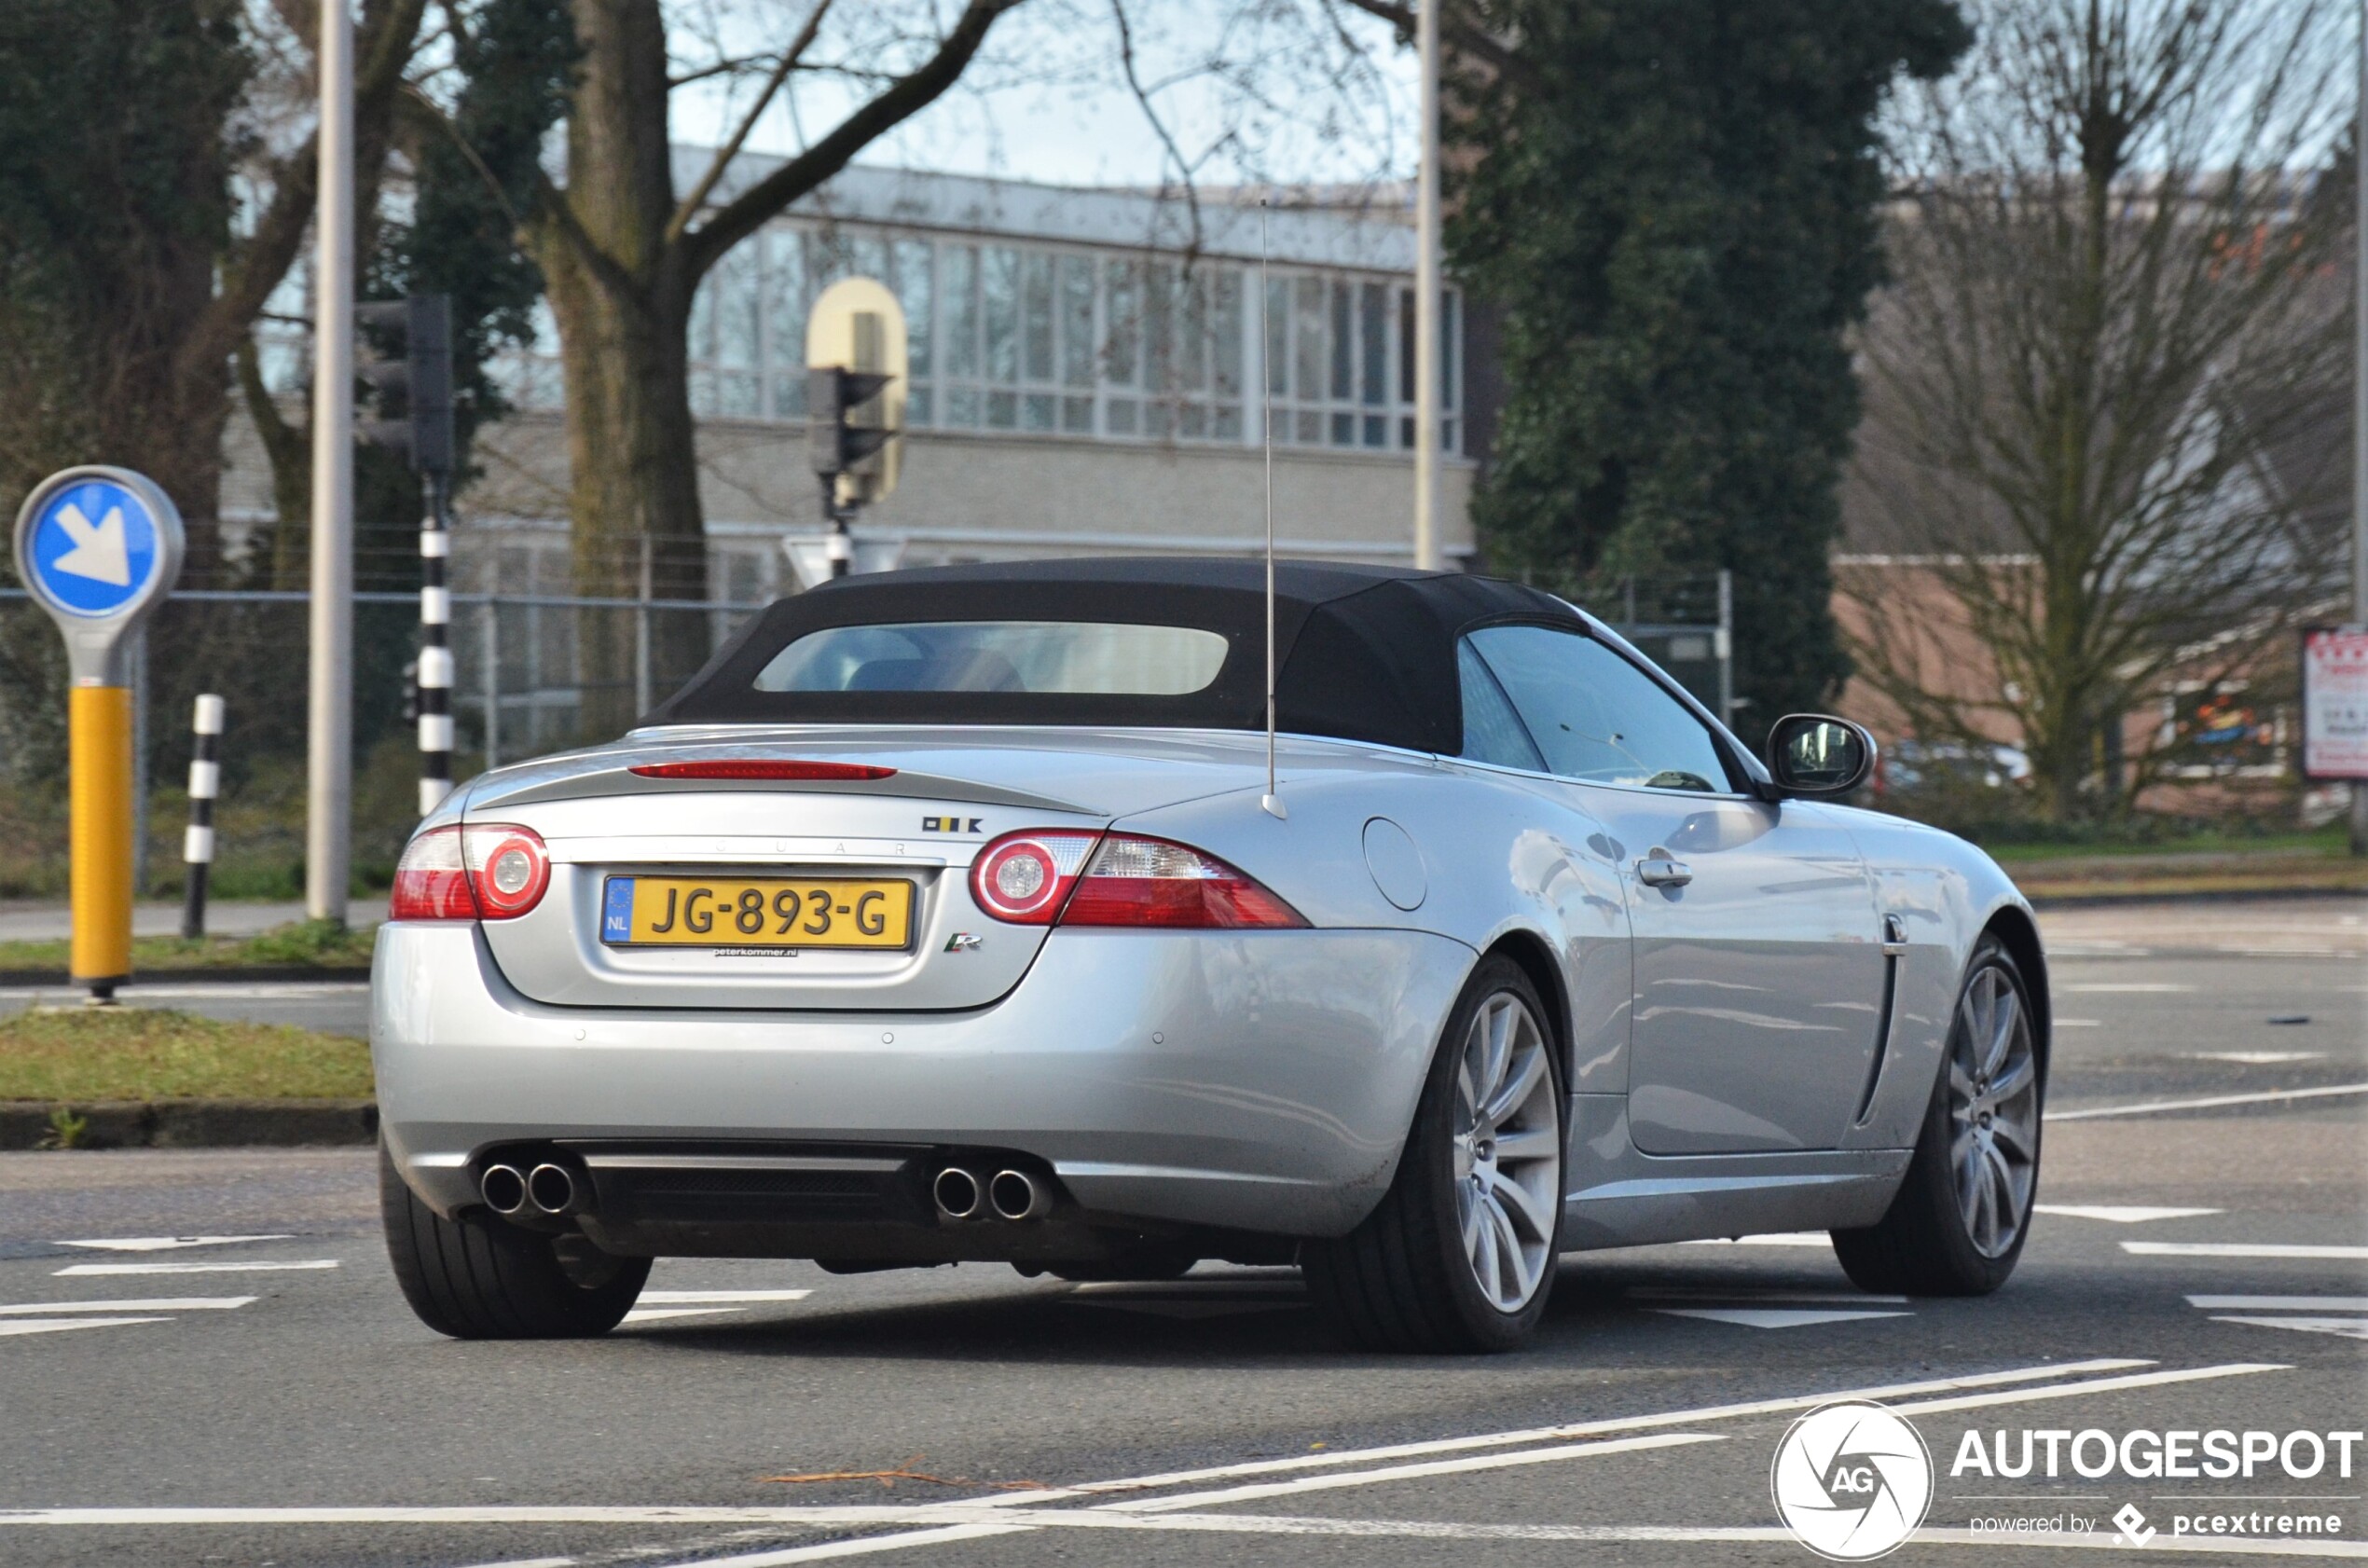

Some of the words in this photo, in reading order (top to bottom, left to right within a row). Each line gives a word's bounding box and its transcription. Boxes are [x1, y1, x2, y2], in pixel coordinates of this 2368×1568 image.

[643, 841, 905, 856] GUAR
[652, 888, 885, 935] JG-893-G
[608, 916, 627, 930] NL
[713, 948, 798, 956] peterkommer.nl
